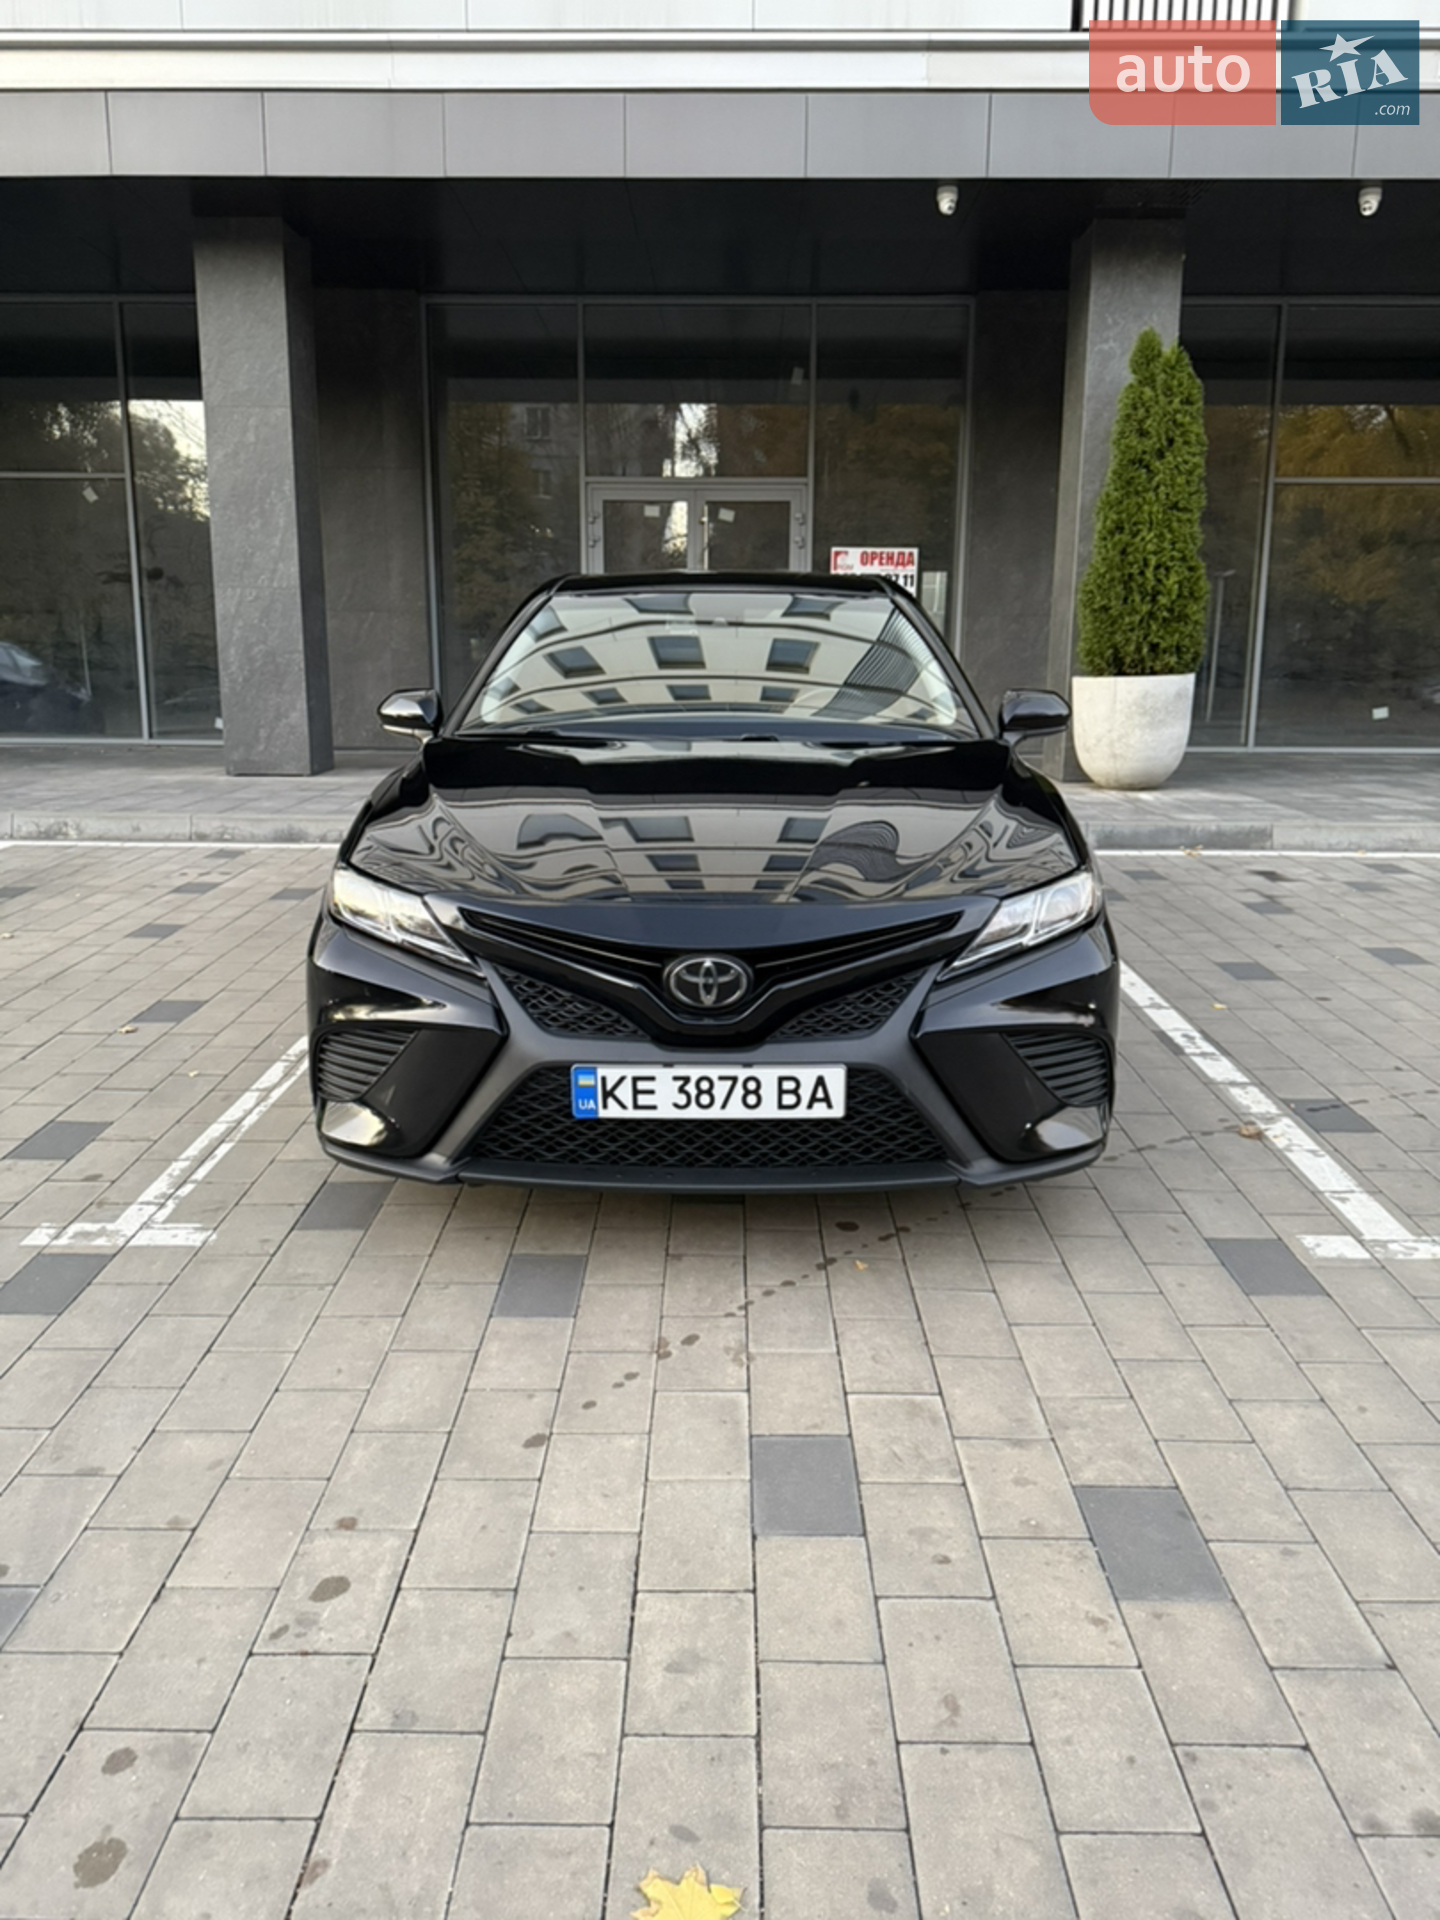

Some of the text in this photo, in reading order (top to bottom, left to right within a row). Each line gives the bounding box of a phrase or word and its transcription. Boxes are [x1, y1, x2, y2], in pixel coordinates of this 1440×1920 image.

[860, 550, 915, 568] ОРЕНДА
[902, 574, 914, 587] 11
[600, 1075, 834, 1110] KE 3878 BA
[578, 1098, 596, 1110] UA
